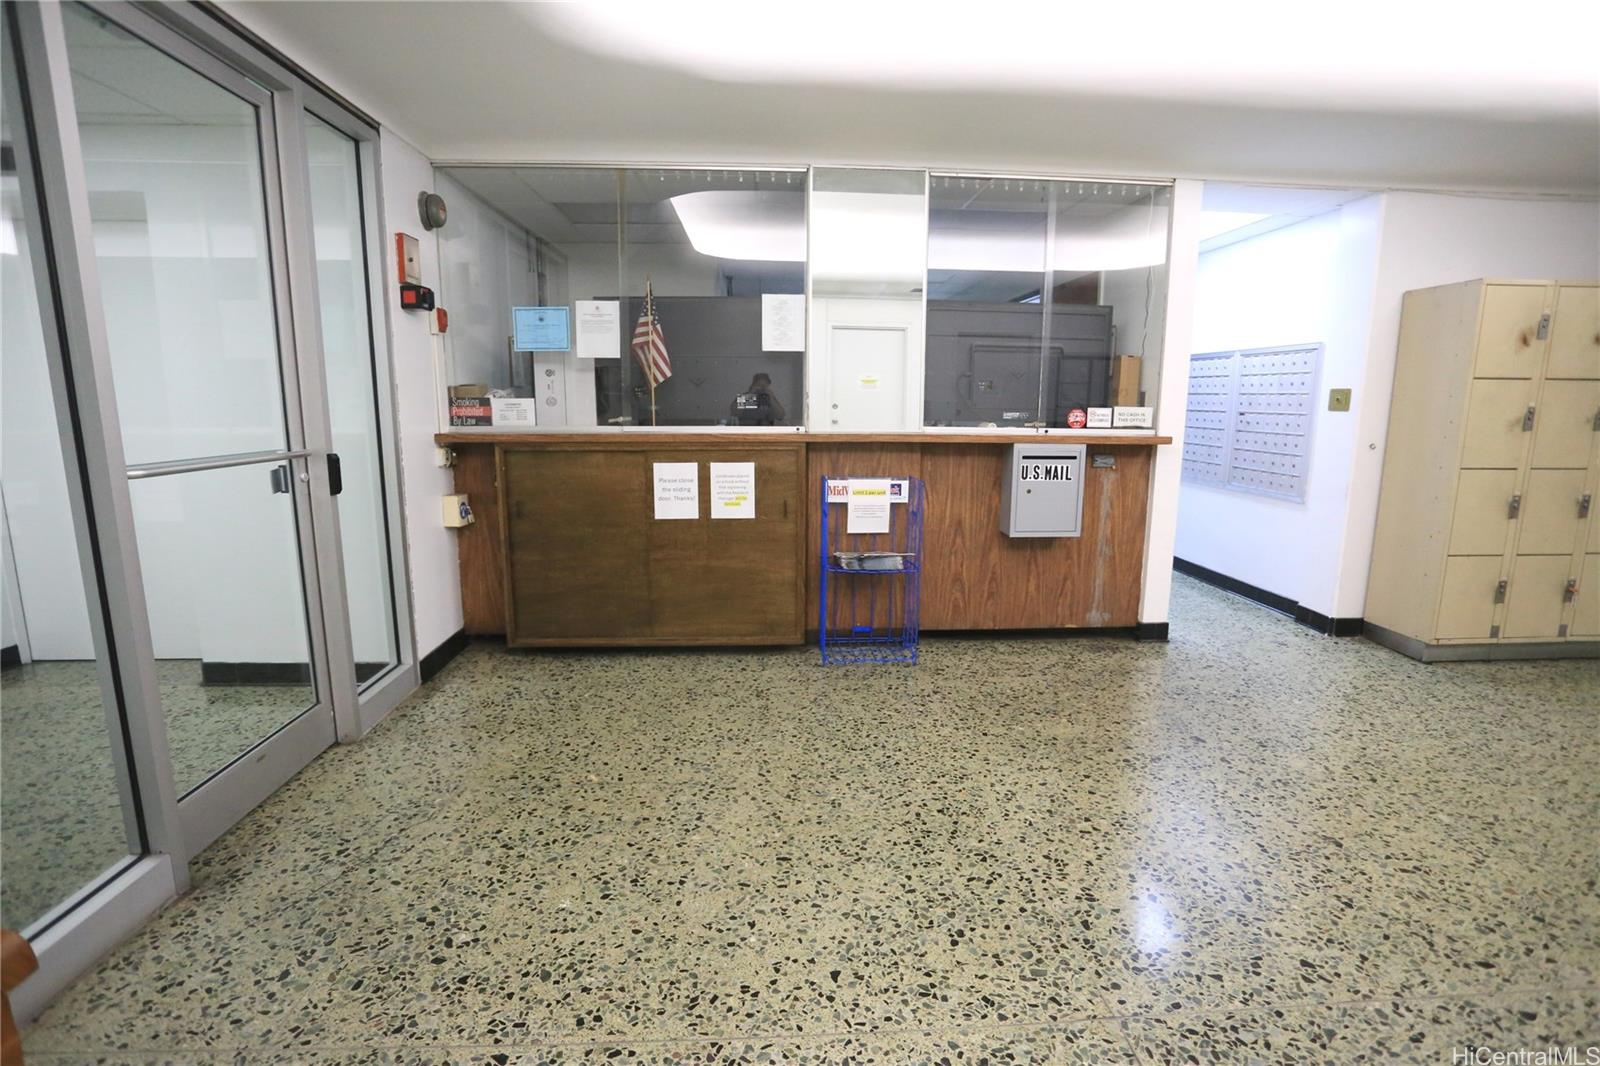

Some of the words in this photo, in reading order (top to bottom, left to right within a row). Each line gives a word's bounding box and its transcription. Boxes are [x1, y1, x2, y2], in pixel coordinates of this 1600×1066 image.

[452, 397, 479, 408] Smoking
[452, 407, 483, 417] Prohibited
[453, 416, 461, 426] By
[463, 417, 476, 425] Law
